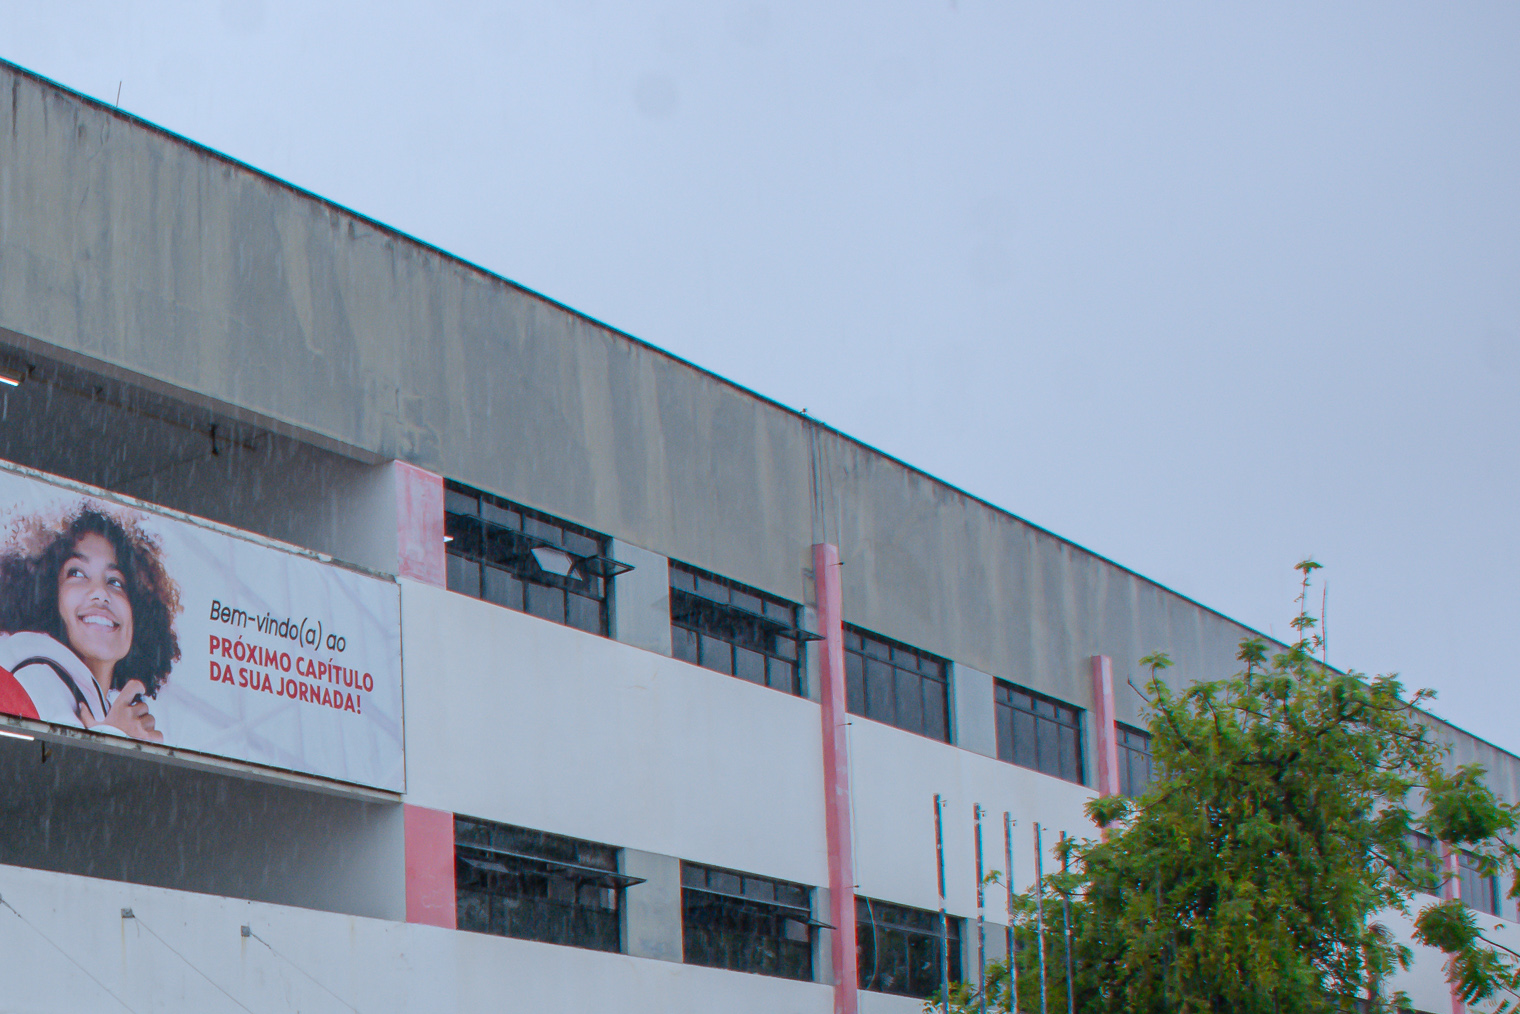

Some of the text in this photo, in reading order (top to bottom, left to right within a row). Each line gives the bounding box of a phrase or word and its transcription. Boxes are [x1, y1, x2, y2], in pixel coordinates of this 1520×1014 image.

[209, 599, 346, 652] Bem-vindo(a) ao
[209, 634, 374, 693] PRÓXIMO CAPÍTULO
[209, 660, 361, 715] DA SUA JORNADA!
